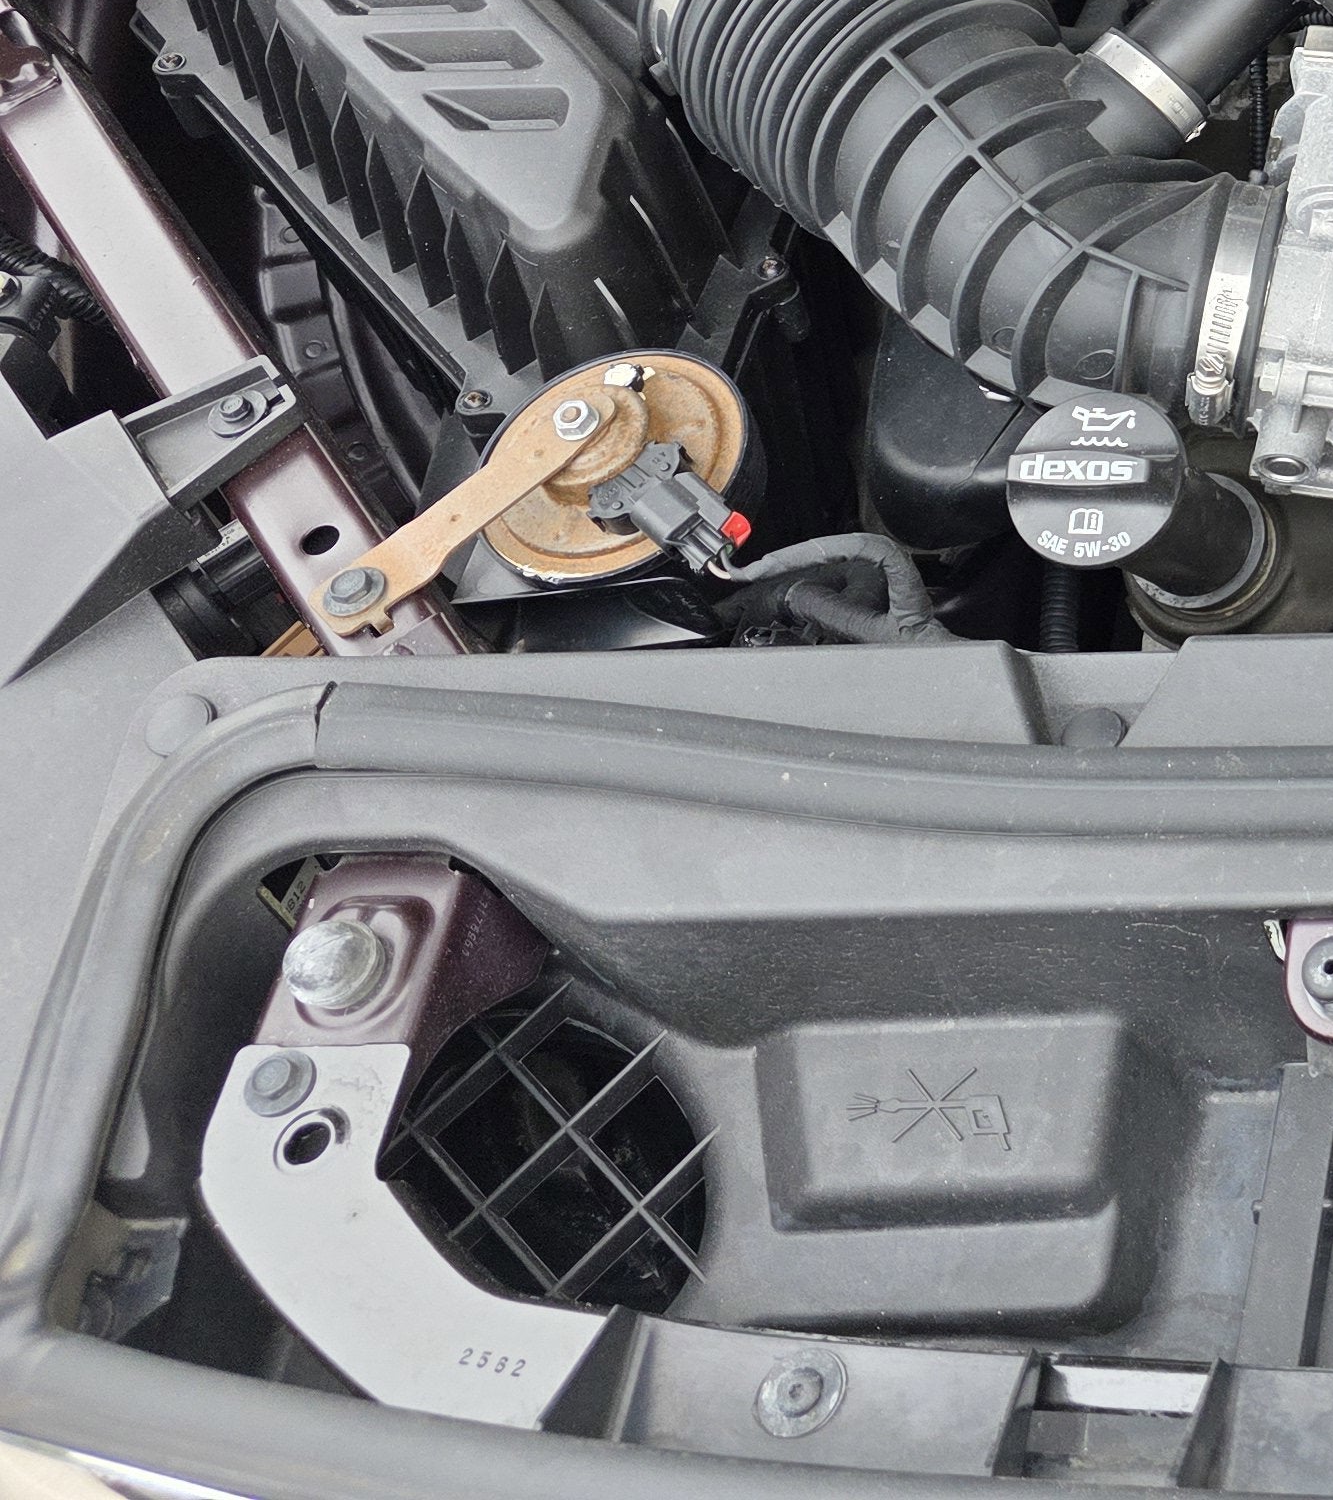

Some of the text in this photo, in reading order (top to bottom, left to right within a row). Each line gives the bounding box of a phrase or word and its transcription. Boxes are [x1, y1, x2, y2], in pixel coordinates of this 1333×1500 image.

[1019, 453, 1134, 481] dexos
[1037, 529, 1132, 558] SAE 5W-30
